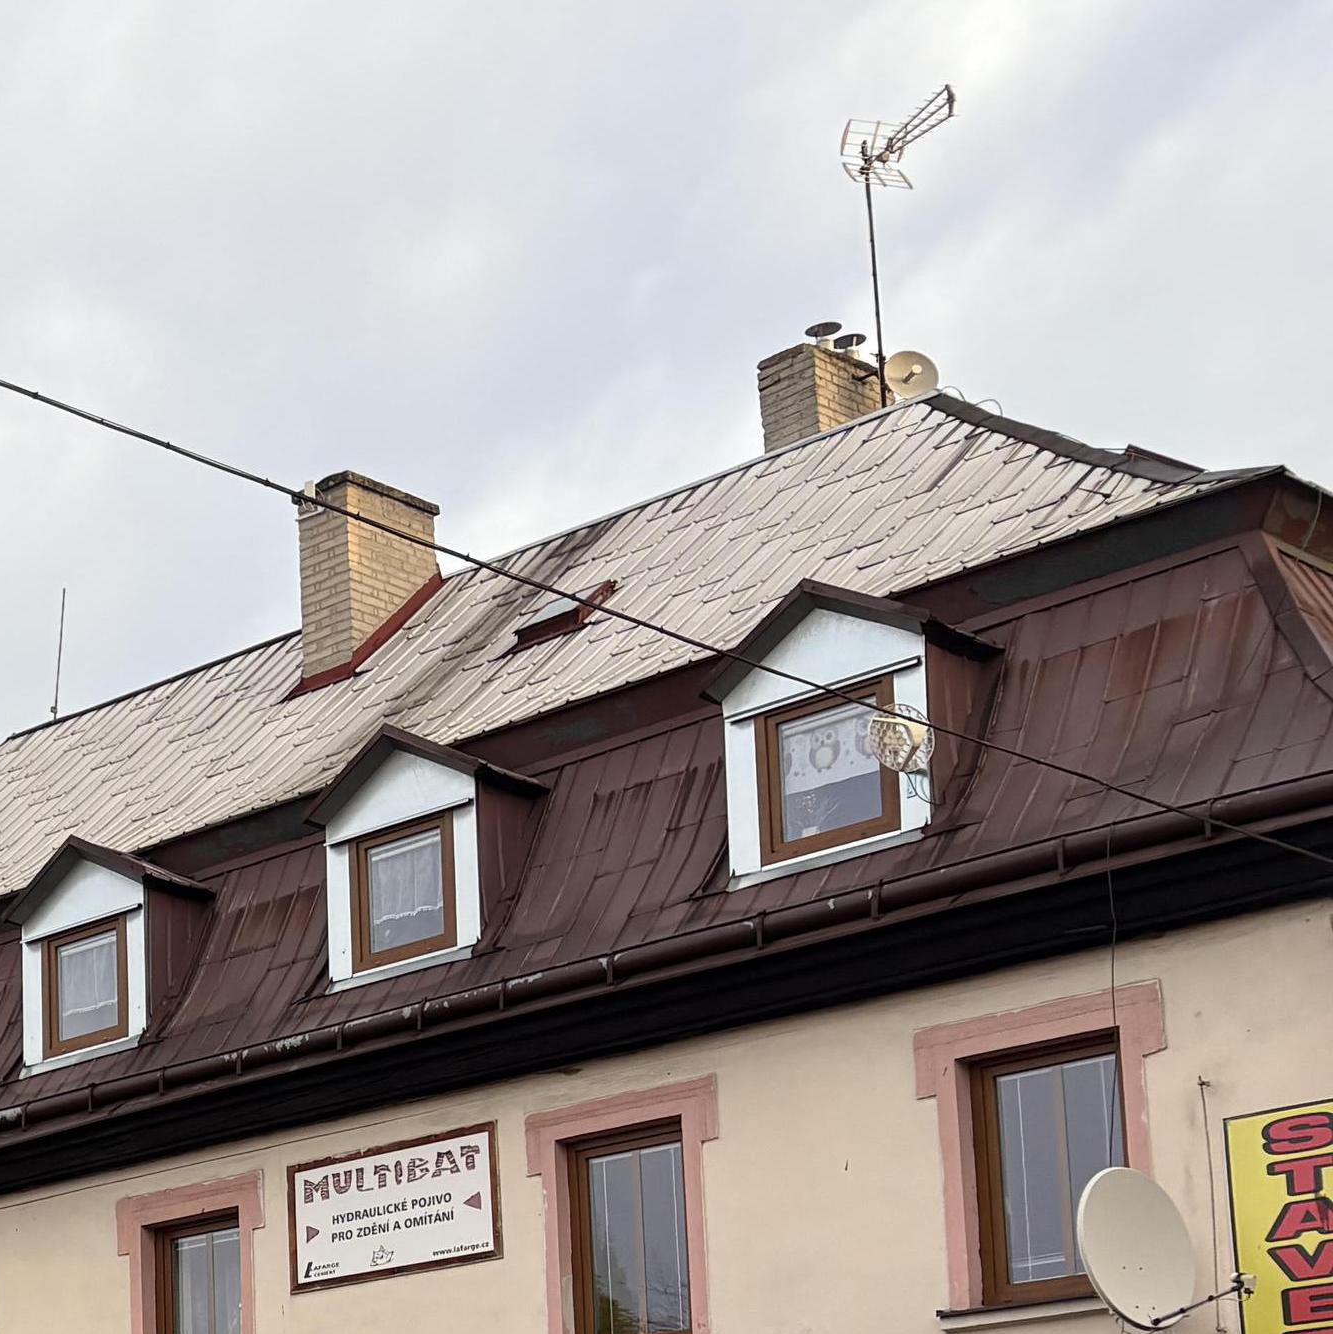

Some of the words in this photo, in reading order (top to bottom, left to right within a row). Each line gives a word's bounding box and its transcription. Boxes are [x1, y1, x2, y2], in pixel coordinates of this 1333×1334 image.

[303, 1144, 481, 1204] MULTIBAT
[331, 1229, 353, 1243] PRO
[356, 1219, 390, 1238] ZDĚNÍ
[393, 1219, 402, 1231] A
[404, 1206, 455, 1230] OMÍTÁNÍ
[332, 1198, 408, 1225] HYDRAULICKÉ
[411, 1192, 452, 1211] POJIVO
[432, 1240, 490, 1258] www.lafarge.cz
